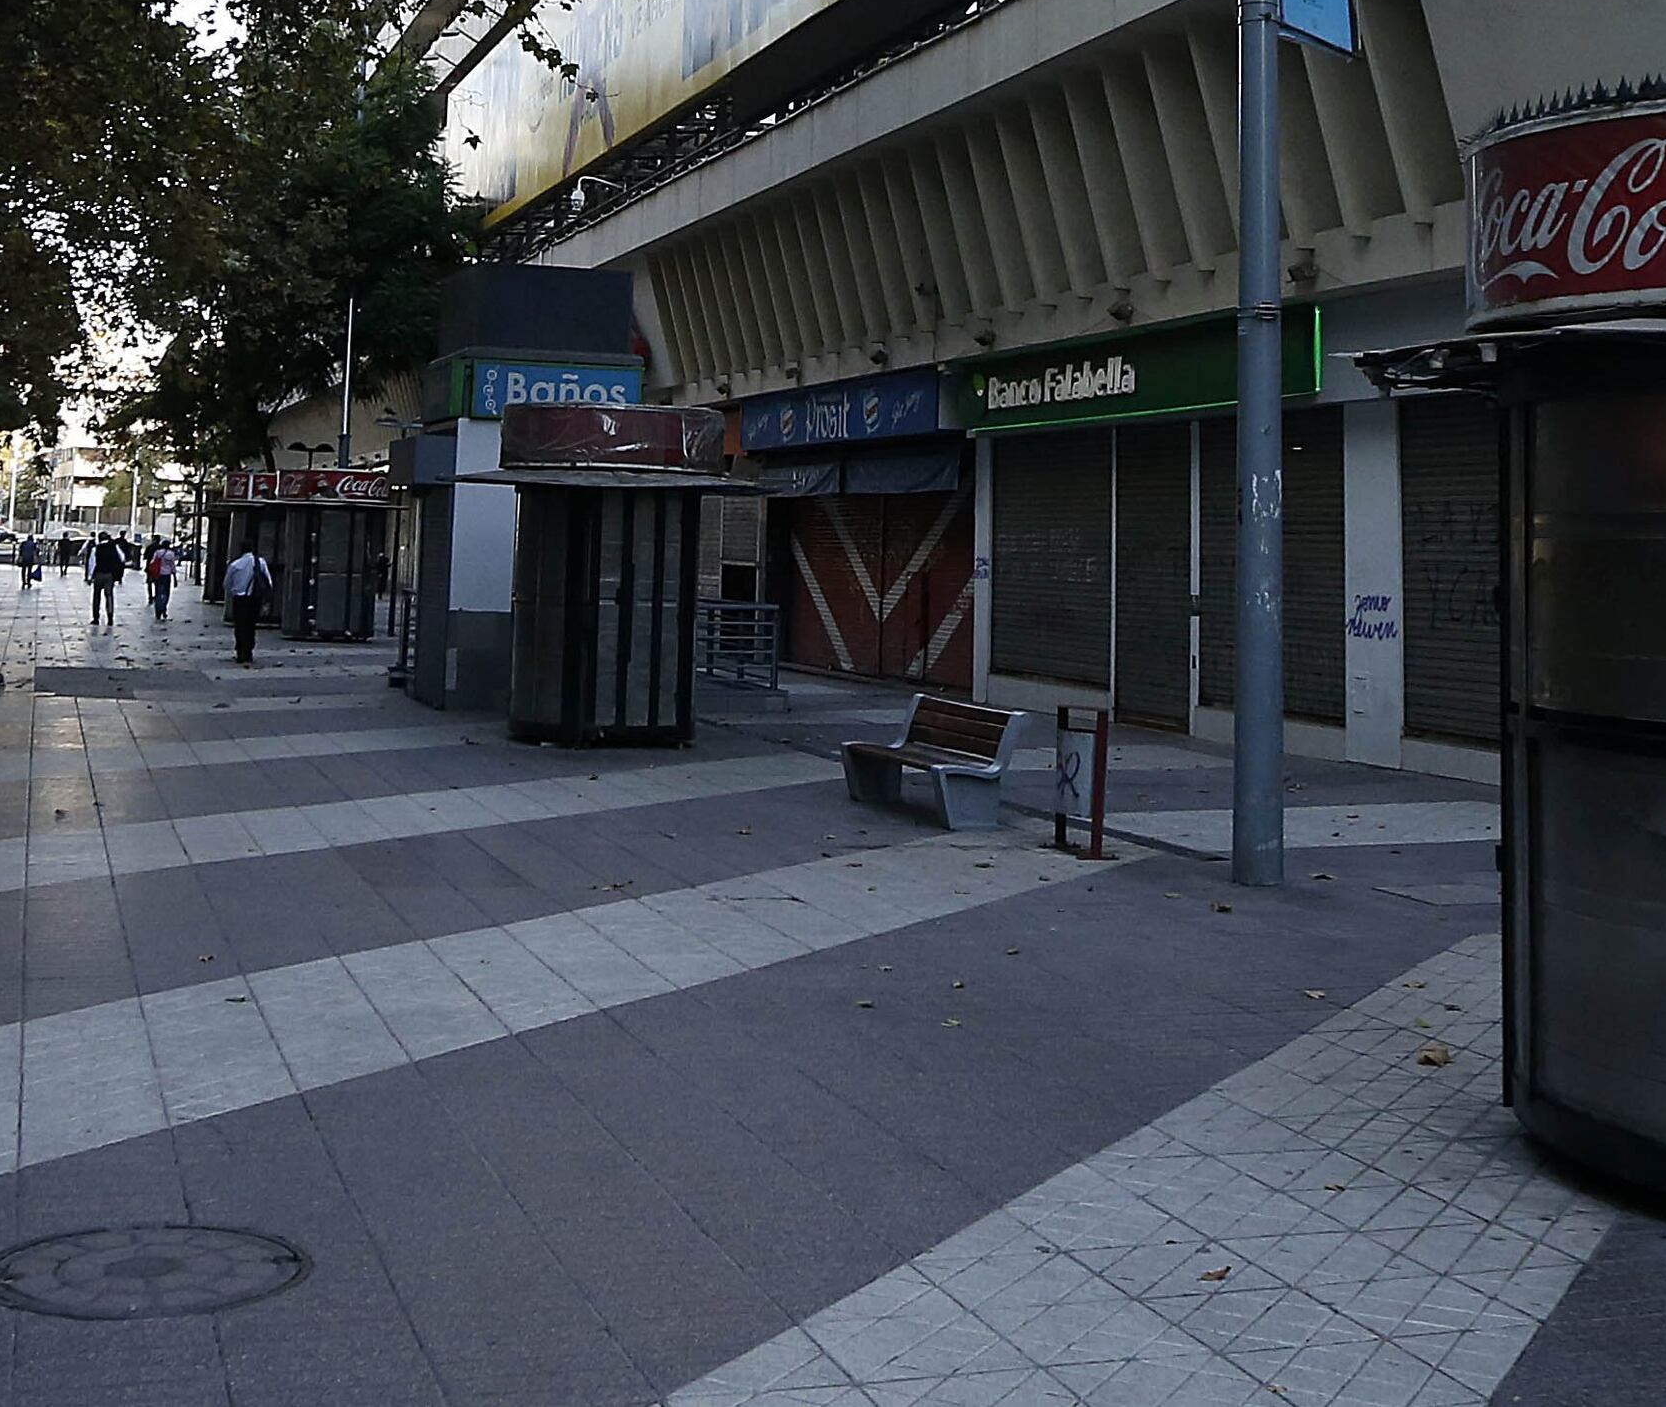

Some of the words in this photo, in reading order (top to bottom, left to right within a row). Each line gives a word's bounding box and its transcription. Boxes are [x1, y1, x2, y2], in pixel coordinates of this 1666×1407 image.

[506, 371, 627, 405] Baños
[988, 376, 1042, 410] Banco
[1044, 356, 1136, 403] Falabella
